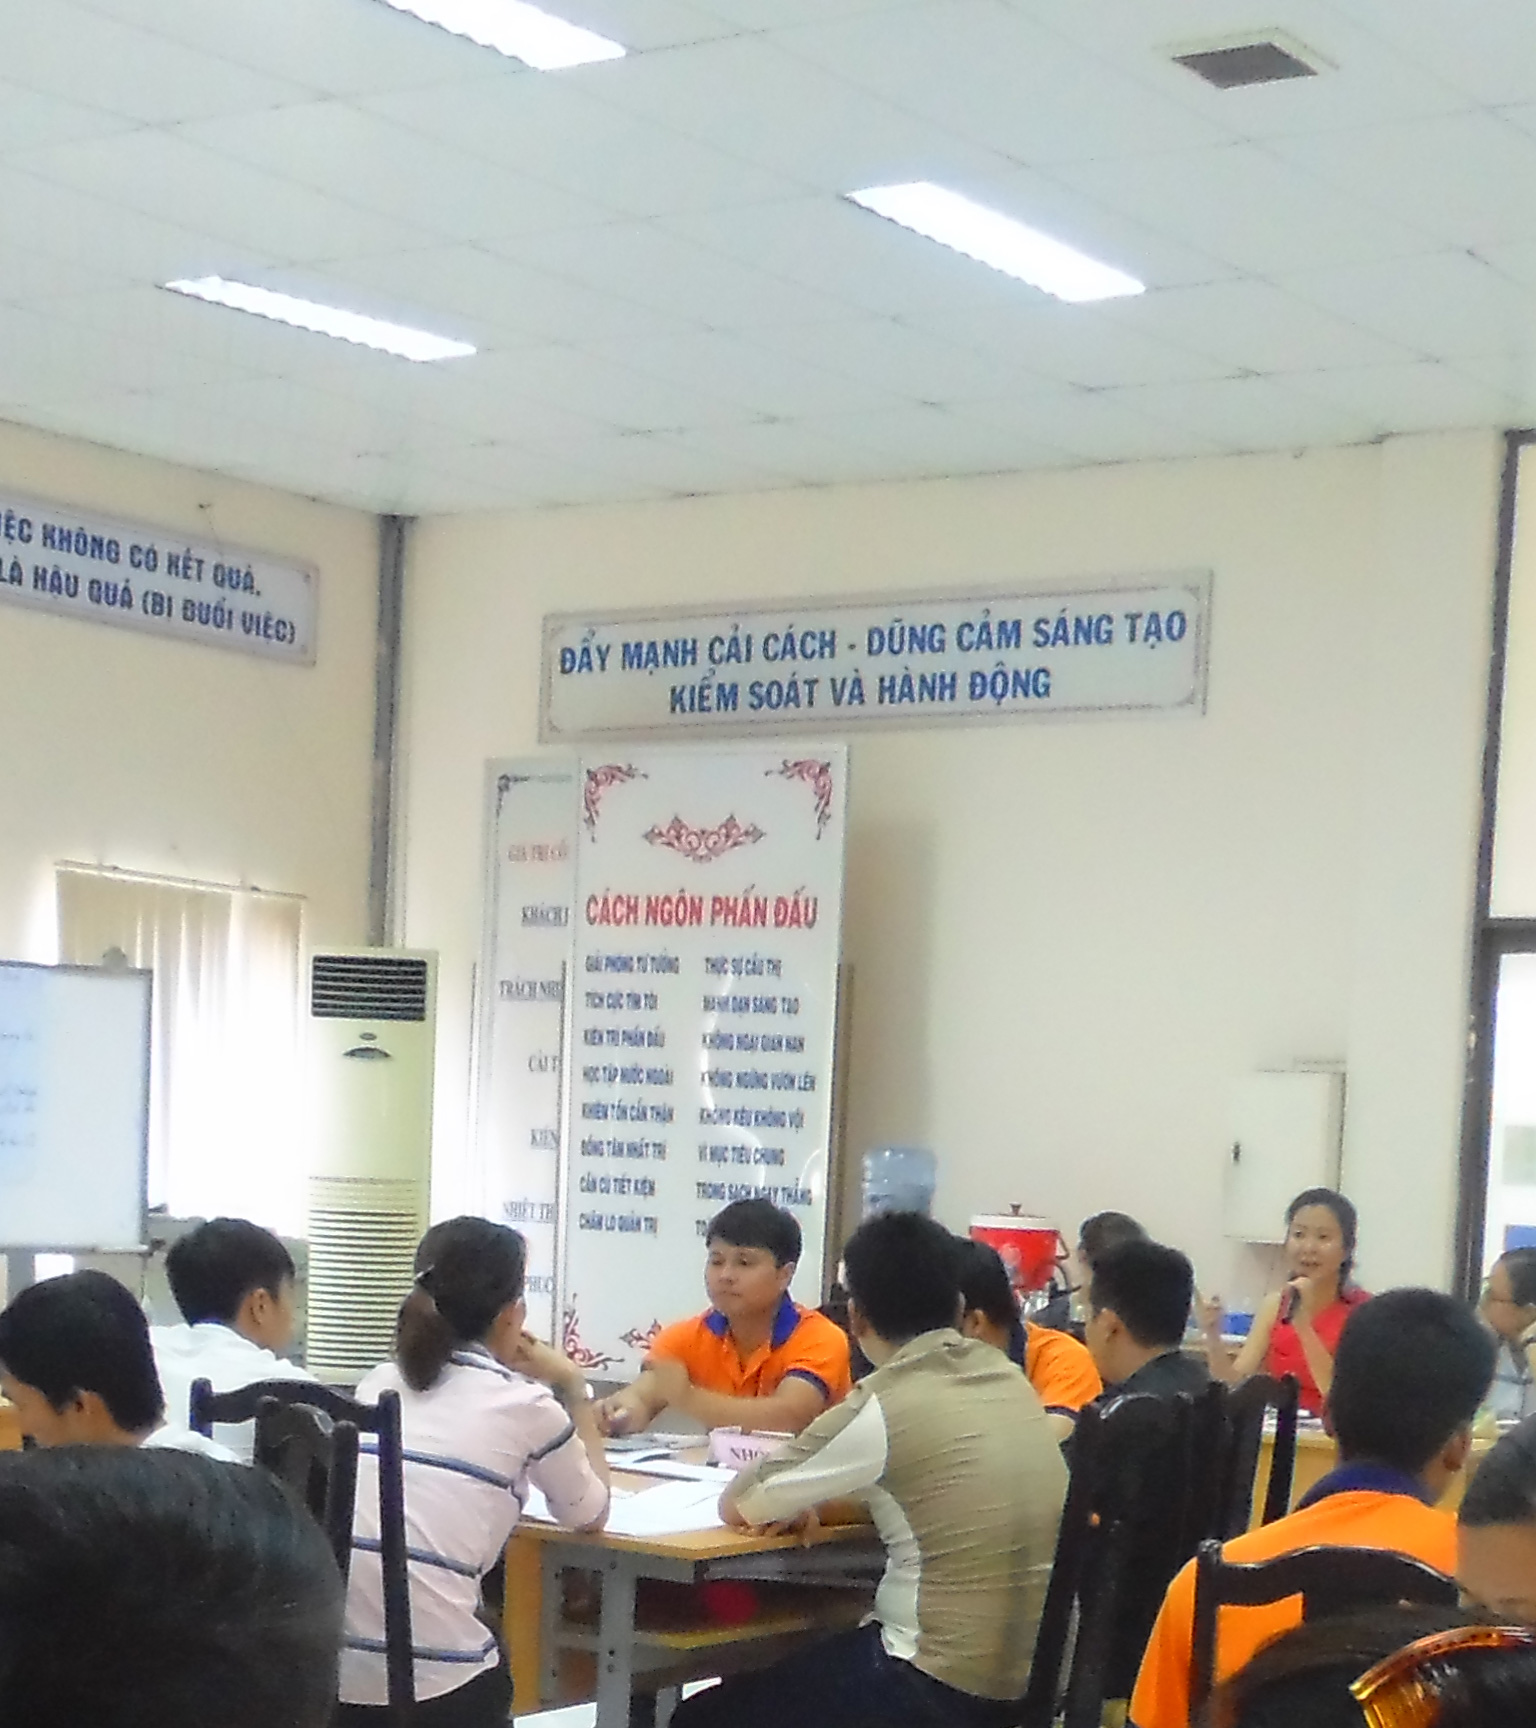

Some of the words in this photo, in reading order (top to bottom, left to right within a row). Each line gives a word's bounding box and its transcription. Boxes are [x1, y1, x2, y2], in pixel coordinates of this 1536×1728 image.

[42, 523, 120, 564] KHÔNG
[129, 543, 158, 573] CÓ
[560, 628, 611, 675] ĐẨY
[621, 637, 698, 677] MẠNH
[707, 624, 753, 668] CẢI
[763, 624, 837, 660] CÁCH
[867, 618, 946, 657] DŨNG
[956, 609, 1022, 651] CẢM
[1033, 607, 1114, 648] SÁNG
[1124, 609, 1187, 650] TẠO
[669, 667, 739, 714] KIỂM
[748, 672, 819, 711] SOÁT
[830, 672, 864, 706] VÀ
[878, 667, 957, 704] HÀNH
[969, 660, 1051, 705] ĐỘNG
[586, 887, 639, 926] CÁCH
[645, 887, 703, 927] NGÔN
[710, 883, 767, 927] PHẤN
[773, 885, 818, 929] ĐẤU
